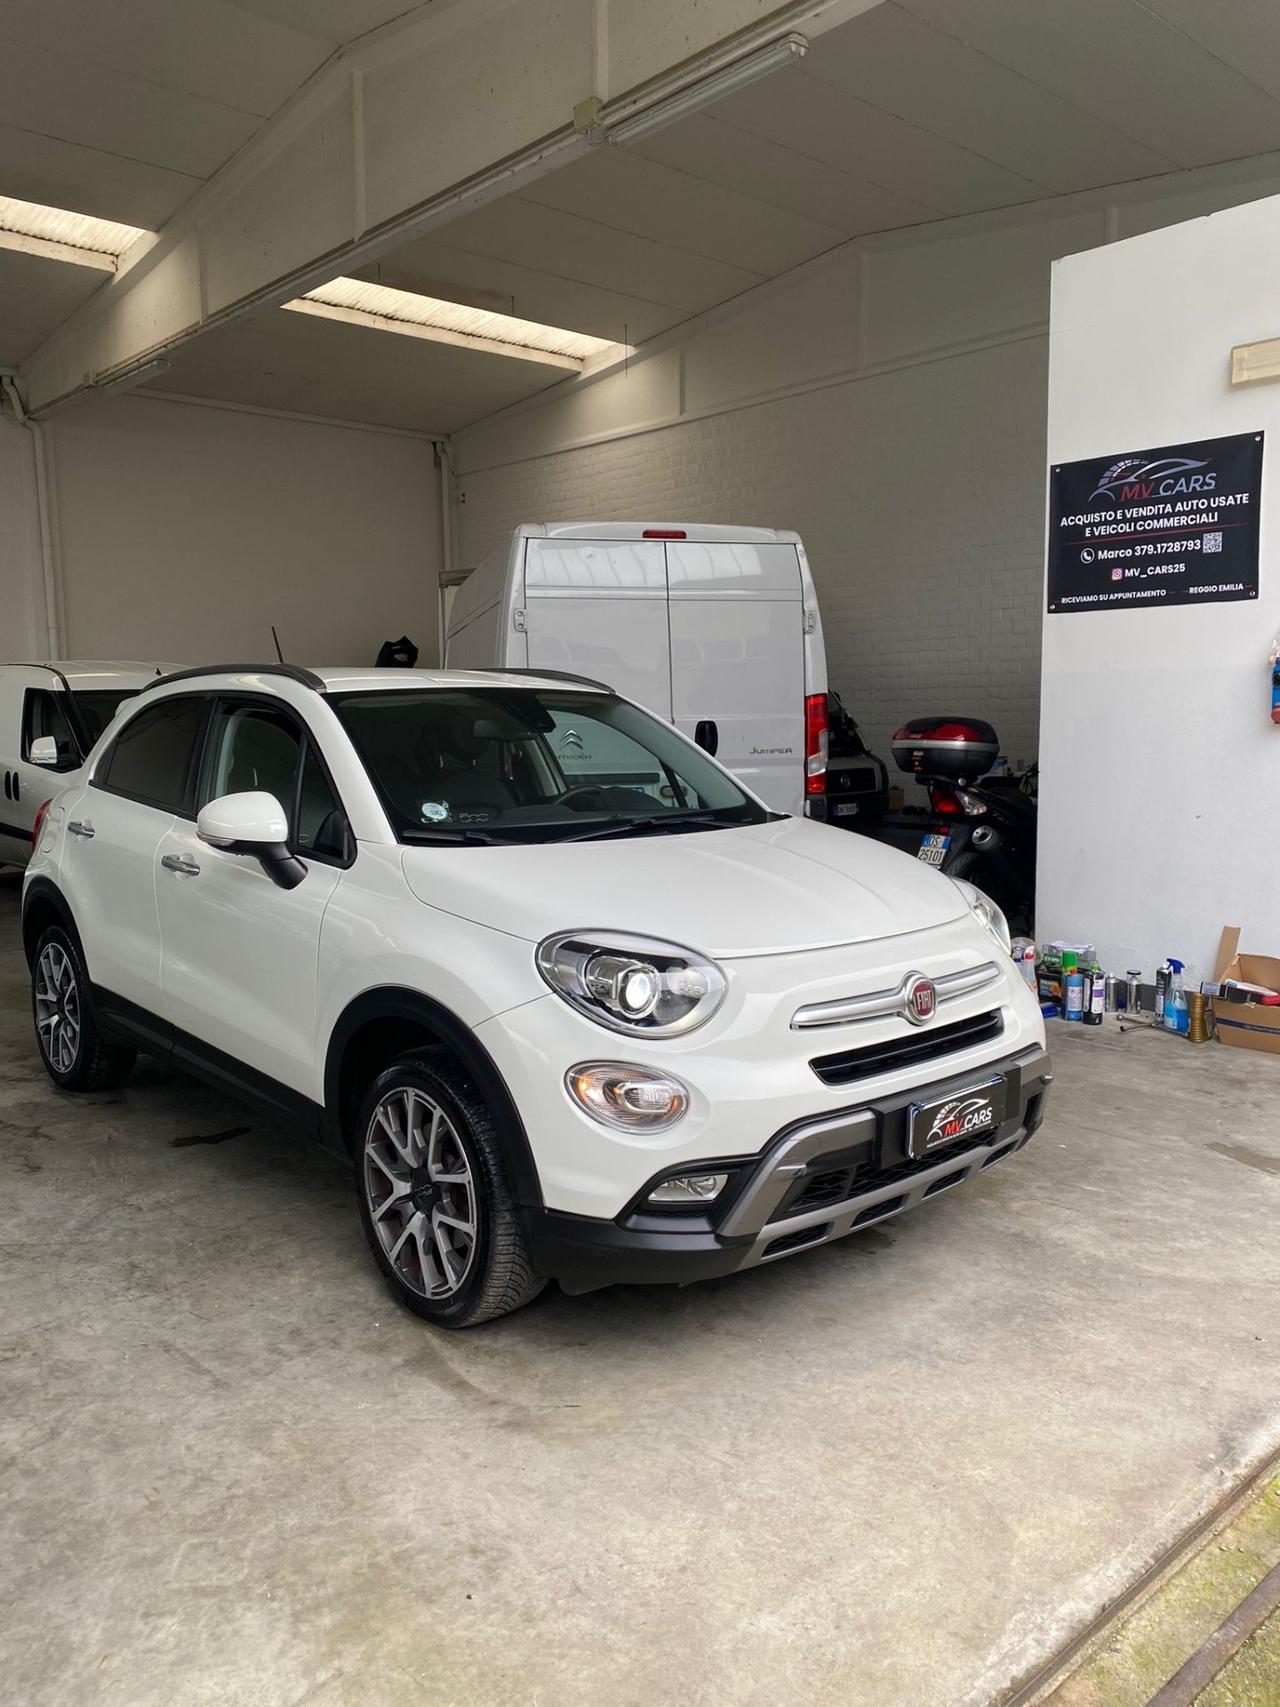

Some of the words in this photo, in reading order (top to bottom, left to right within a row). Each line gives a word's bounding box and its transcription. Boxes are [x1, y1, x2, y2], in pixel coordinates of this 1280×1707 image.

[1120, 482, 1154, 502] MV
[1159, 473, 1217, 497] CARS
[1060, 510, 1115, 527] ACQUISTO
[1117, 508, 1123, 520] E
[1125, 504, 1173, 519] VENDITA
[1175, 498, 1207, 513] AUTO
[1210, 493, 1250, 508] USATE
[1085, 526, 1091, 537] E
[1093, 520, 1135, 536] VEICOLI
[1136, 511, 1218, 531] COMMERCIALI
[1098, 547, 1133, 560] Marco
[1134, 539, 1201, 557] 379.1728793
[1124, 563, 1186, 578] MV_CARS25
[1061, 594, 1098, 604] RICEVIAMO
[1099, 593, 1109, 601] SU
[1109, 589, 1167, 601] APPUNTAMENTO
[1189, 584, 1218, 594] REGGIO
[1218, 582, 1244, 593] EMILIA
[918, 848, 943, 862] 25101
[916, 989, 932, 1011] FIAT
[944, 1118, 964, 1137] MV
[964, 1106, 993, 1128] CARS
